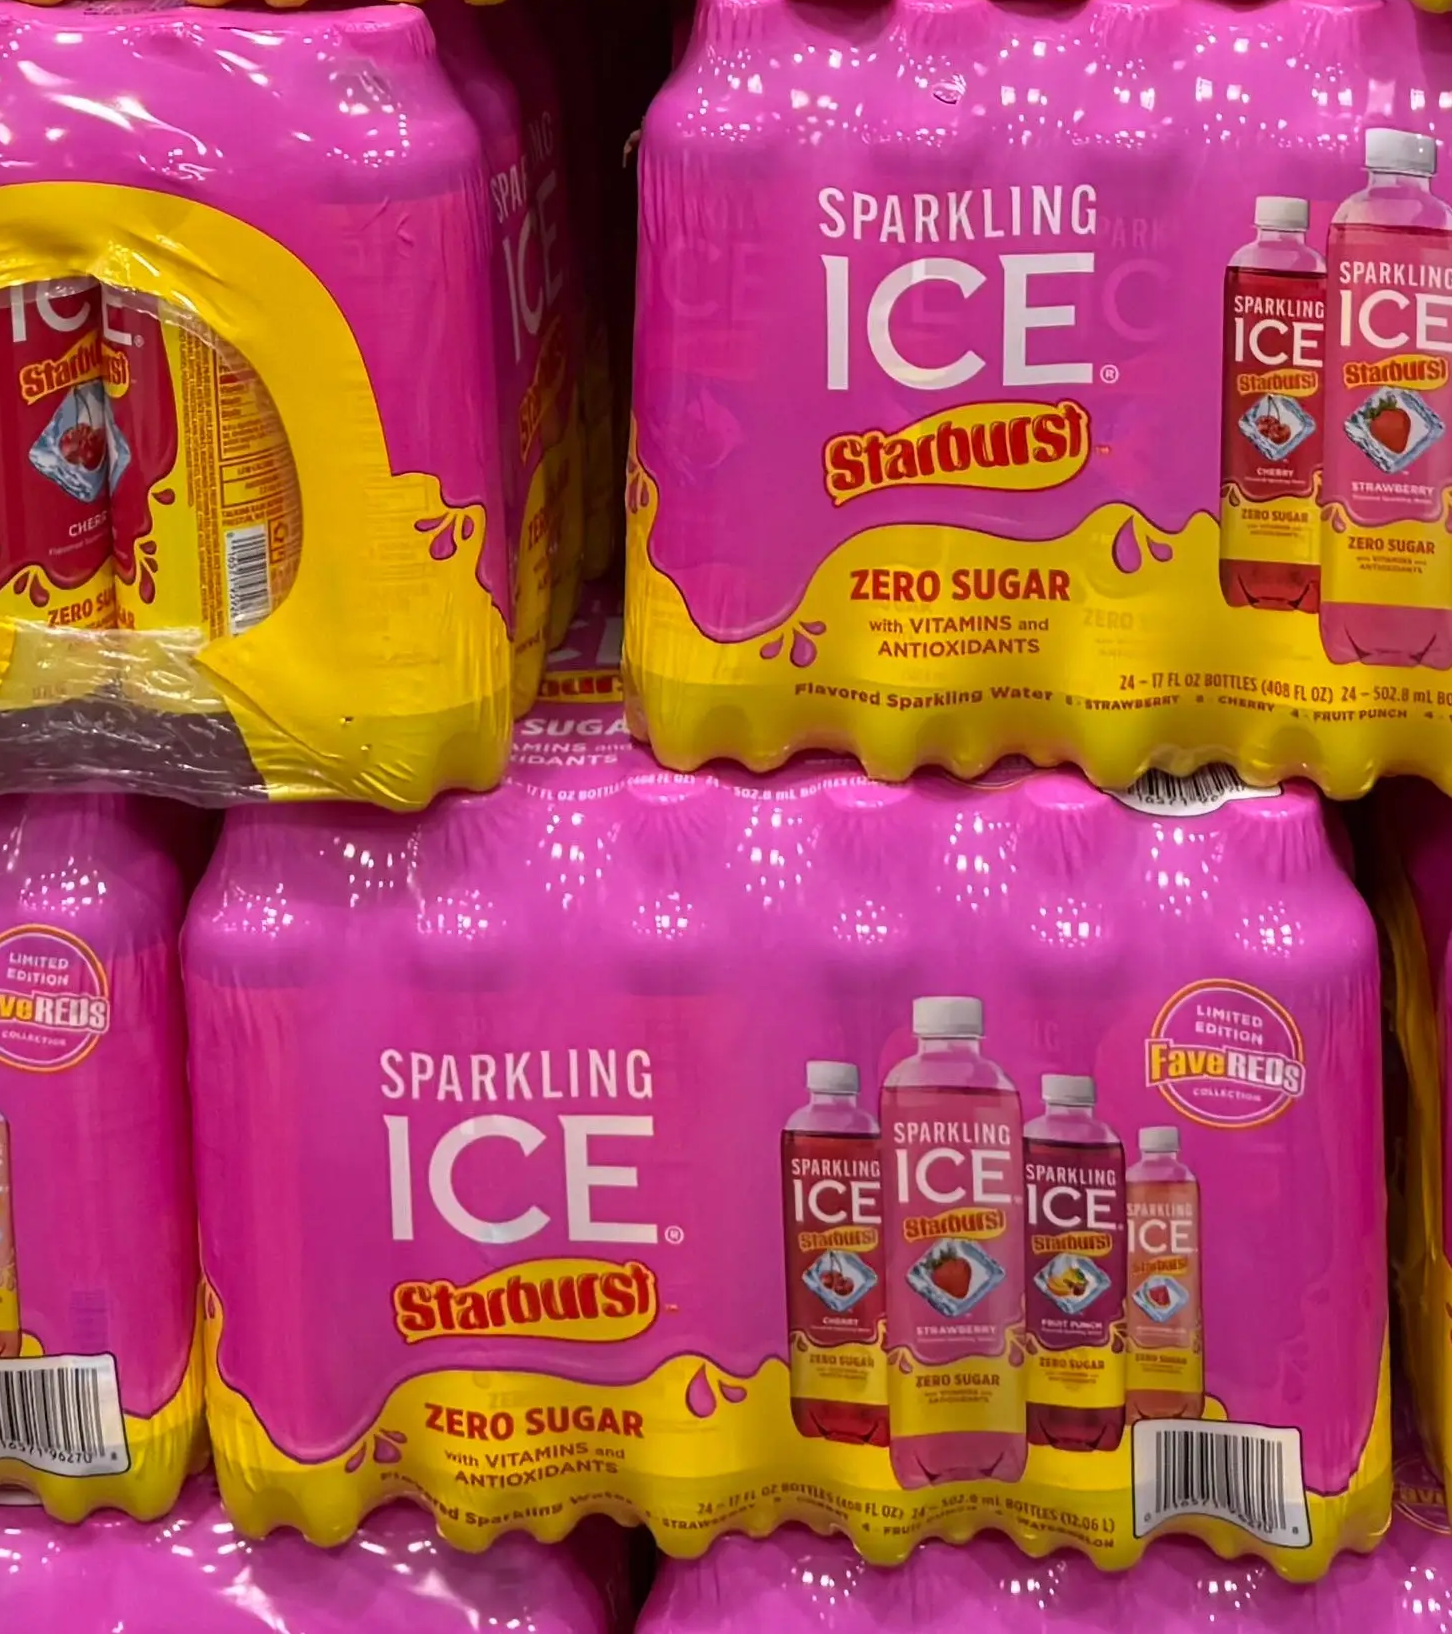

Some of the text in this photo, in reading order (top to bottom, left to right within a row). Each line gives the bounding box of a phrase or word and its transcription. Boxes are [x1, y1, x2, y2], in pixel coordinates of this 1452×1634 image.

[819, 185, 1096, 242] SPARKLING
[830, 403, 1087, 495] Starburst
[851, 569, 1069, 602] ZERO SUGAR
[48, 598, 92, 627] ZERO
[873, 616, 1047, 633] with VITAMINS and
[879, 638, 1040, 657] ANTIOXIDANTS
[1197, 1007, 1264, 1028] LIMITED
[1195, 1022, 1264, 1046] EDITION
[381, 1049, 652, 1101] SPARKLING
[1193, 1088, 1262, 1102] COLLECTION
[401, 1259, 655, 1345] Starburst
[425, 1403, 642, 1441] ZERO SUGAR
[485, 1442, 588, 1469] VITAMINS
[455, 1459, 618, 1488] ANTIOXIDANTS
